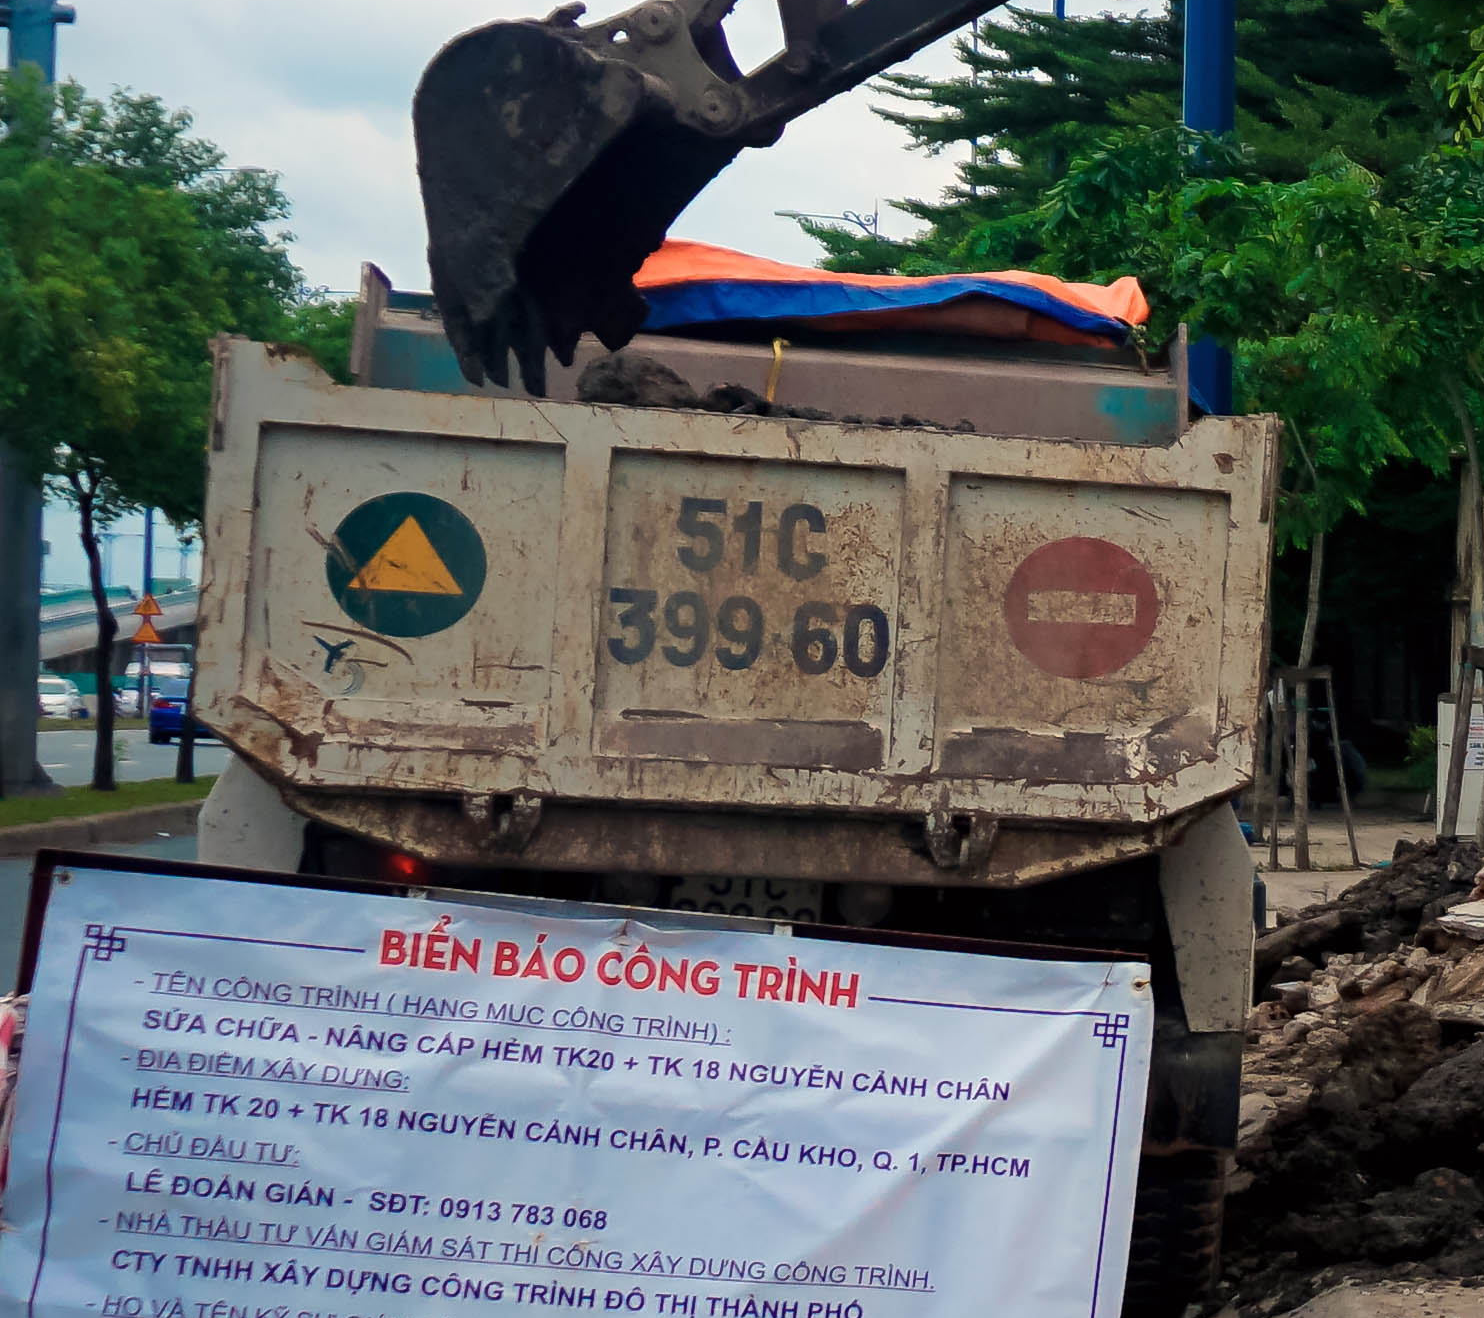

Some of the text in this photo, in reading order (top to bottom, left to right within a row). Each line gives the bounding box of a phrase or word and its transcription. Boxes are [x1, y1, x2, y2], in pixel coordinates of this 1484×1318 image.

[676, 496, 830, 582] 51C
[380, 913, 860, 1009] BIỂN BÁO CÔNG TRÌNH
[552, 1046, 615, 1071] TK20
[647, 1055, 684, 1078] TK
[692, 1058, 721, 1081] 18
[203, 1093, 241, 1116] TK
[248, 1096, 279, 1120] 20
[312, 1102, 351, 1126] TK
[359, 1106, 389, 1129] 18
[704, 1137, 724, 1158] P.
[799, 1143, 863, 1173] KHO,
[873, 1150, 898, 1172] Q.
[908, 1151, 927, 1176] 1,
[936, 1153, 1031, 1178] TP.HCM
[439, 1197, 502, 1222] 0913
[511, 1203, 555, 1227] 783
[563, 1207, 608, 1231] 068
[111, 1249, 167, 1274] CTY
[175, 1254, 254, 1282] TNHH
[499, 1240, 539, 1264] THI
